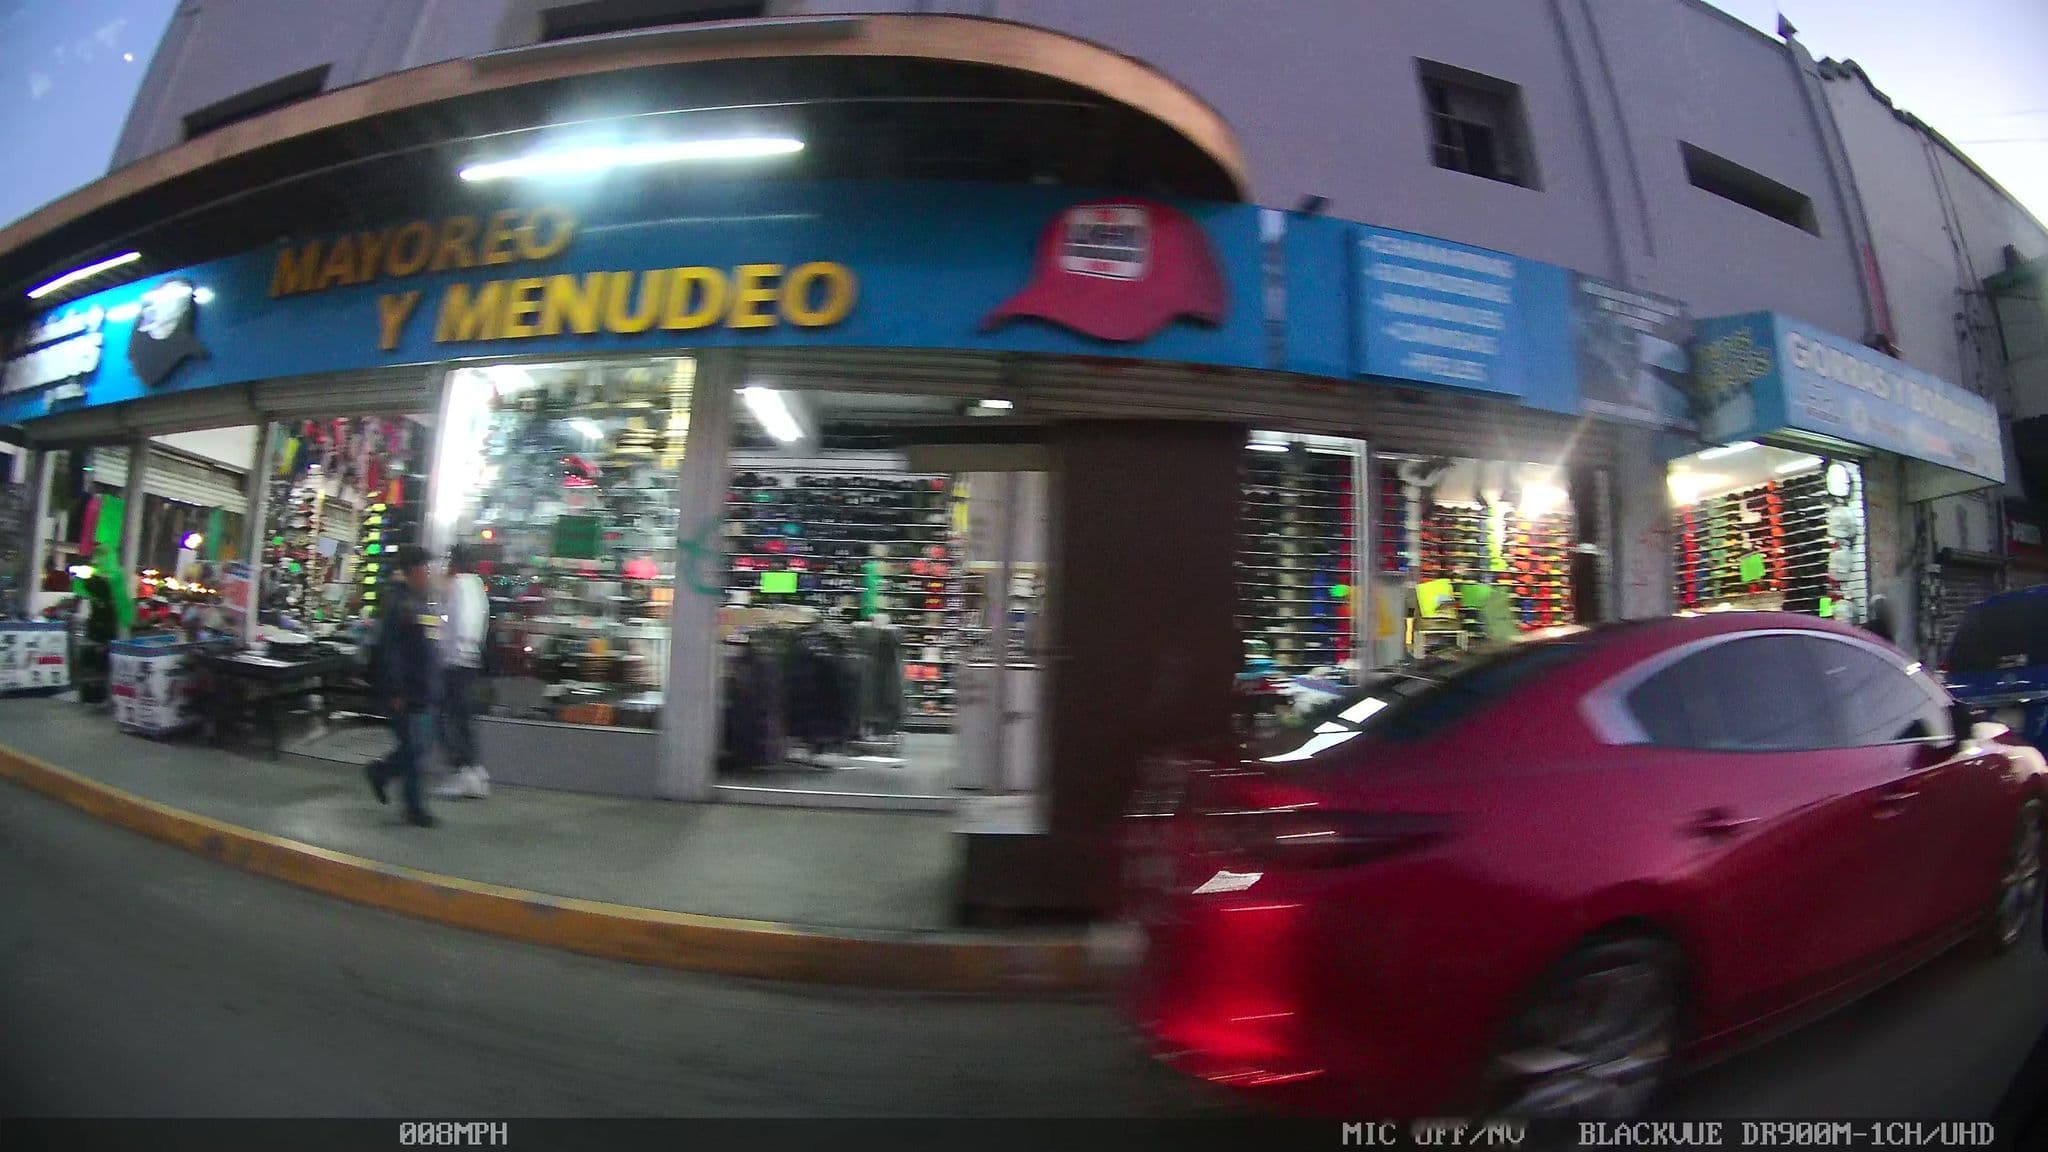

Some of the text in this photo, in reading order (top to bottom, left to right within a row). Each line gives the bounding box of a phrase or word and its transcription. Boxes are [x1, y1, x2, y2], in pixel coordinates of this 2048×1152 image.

[271, 206, 577, 297] MAYOREO
[376, 261, 858, 350] Y MENUDEO
